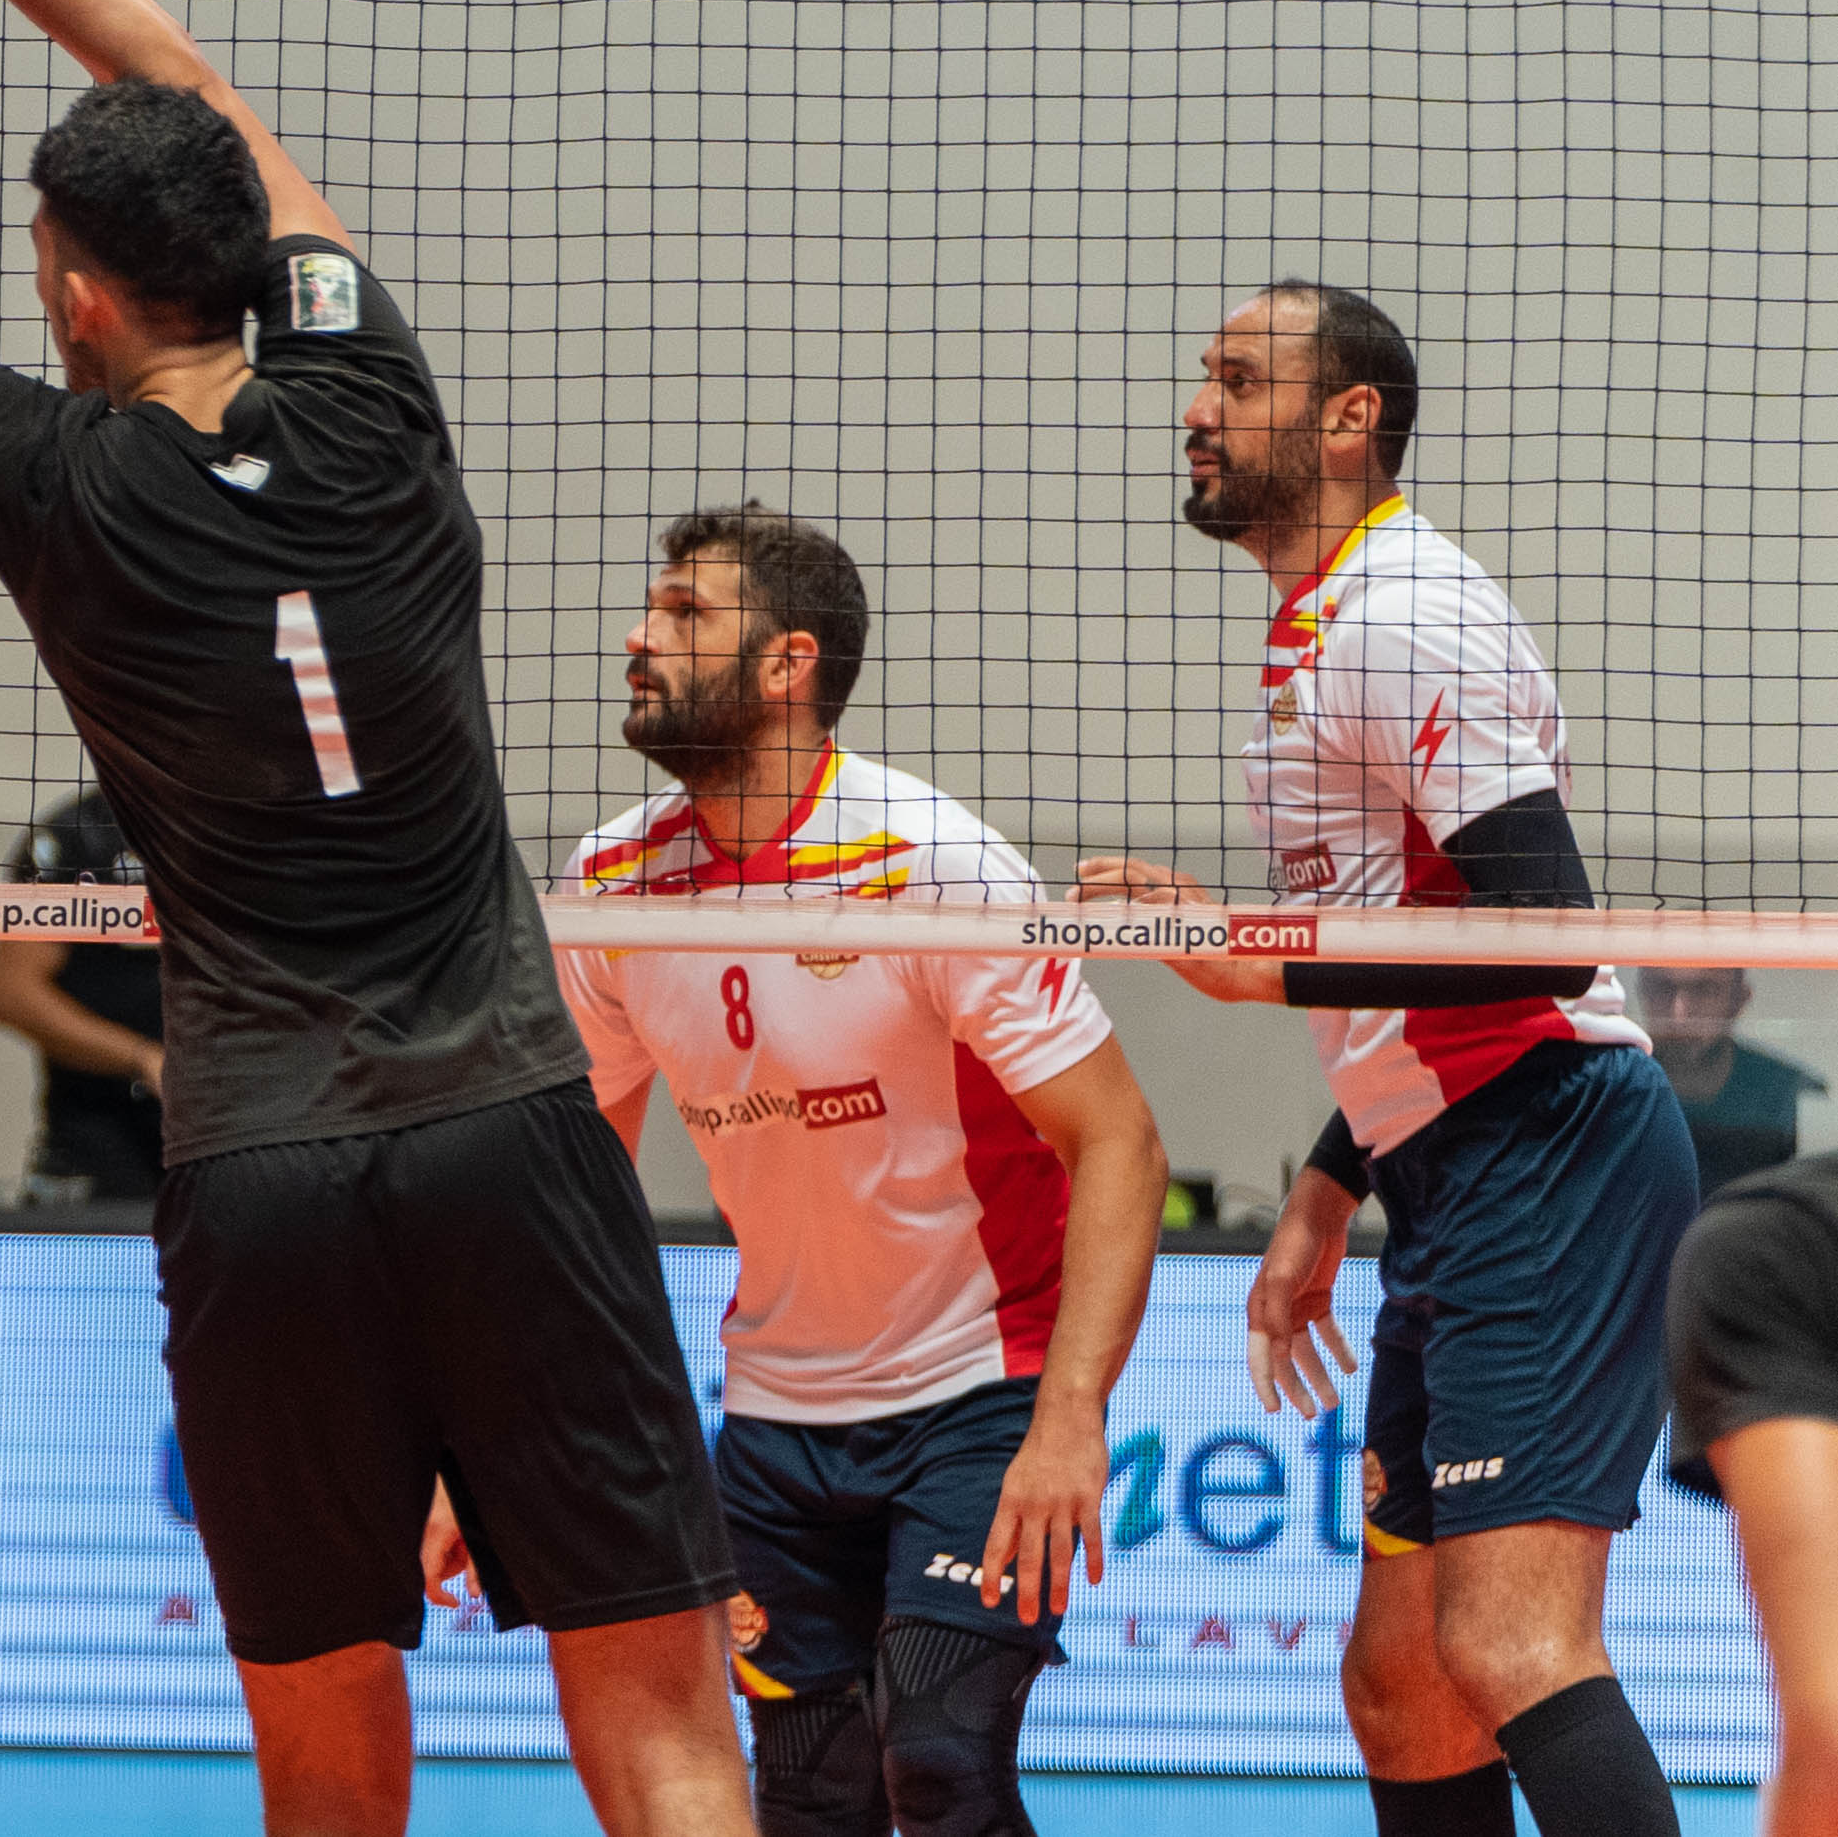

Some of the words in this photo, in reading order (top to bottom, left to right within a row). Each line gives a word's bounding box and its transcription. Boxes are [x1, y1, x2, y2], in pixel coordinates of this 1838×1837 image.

[275, 590, 361, 796] 1
[1022, 915, 1309, 954] shop.callipo.com
[721, 965, 754, 1050] 8
[1431, 1457, 1504, 1490] Zeus
